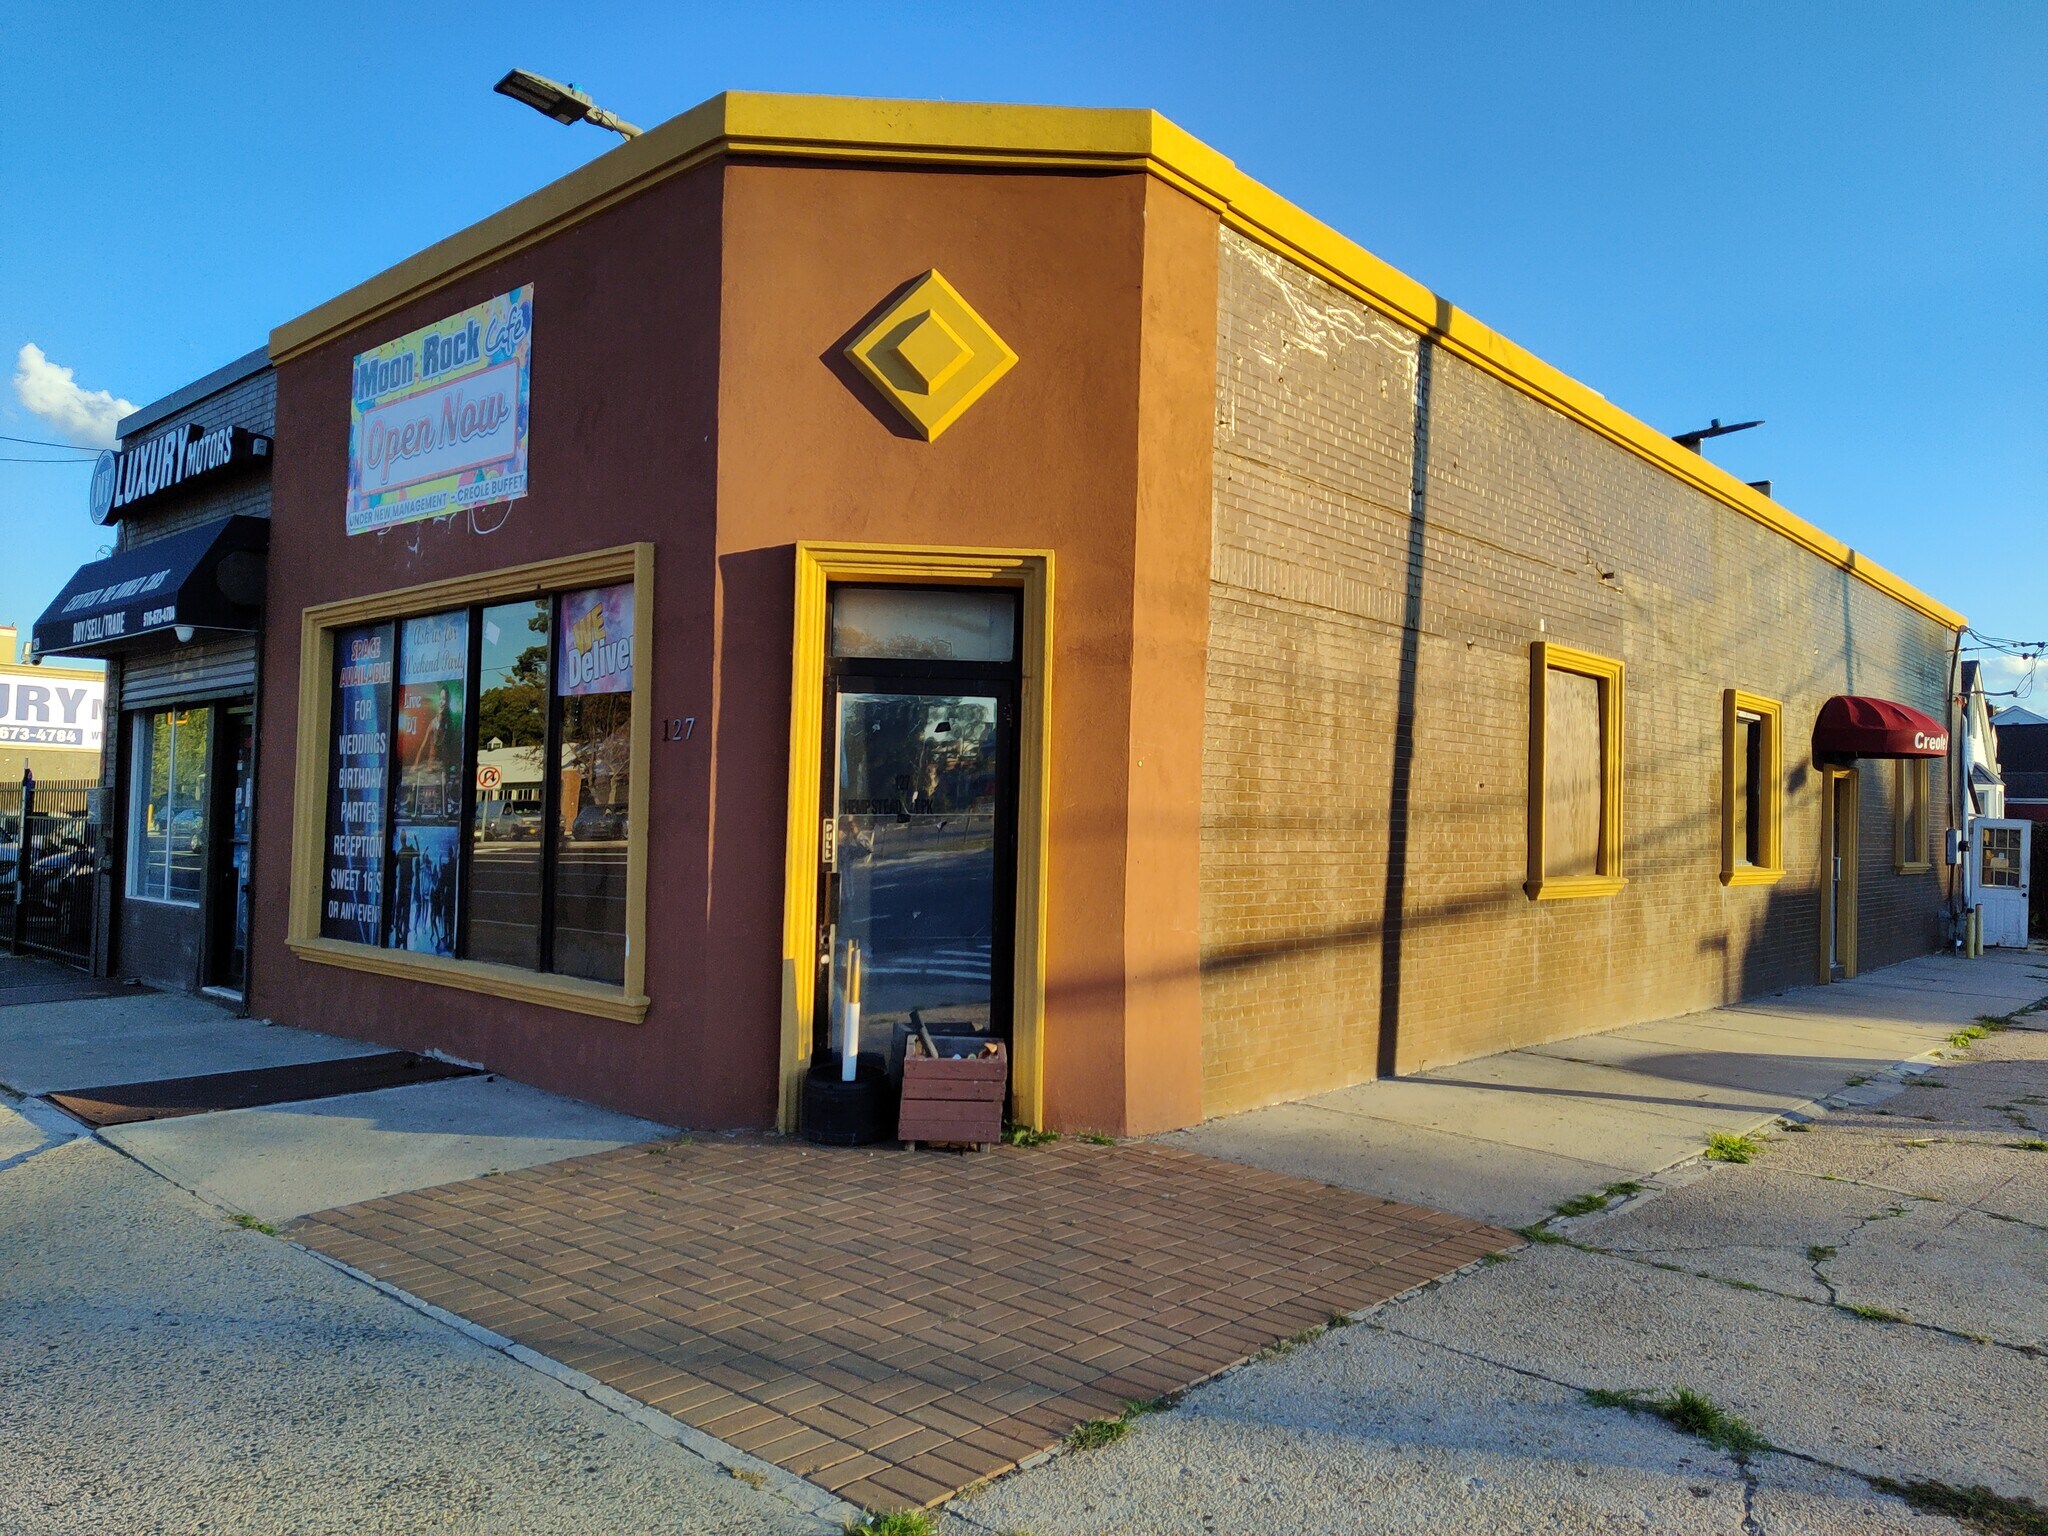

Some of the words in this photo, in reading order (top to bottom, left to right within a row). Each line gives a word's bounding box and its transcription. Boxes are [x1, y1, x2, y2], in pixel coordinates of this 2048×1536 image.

[358, 350, 415, 402] Moon
[422, 317, 481, 381] Rock
[367, 415, 436, 485] Open
[436, 389, 511, 449] Now
[113, 423, 191, 508] LUXURY
[185, 425, 233, 479] MOTORS
[349, 512, 373, 527] UNDER
[374, 506, 391, 521] NEW
[392, 493, 448, 518] MANAGEMENT
[457, 485, 490, 502] CREOLE
[491, 474, 525, 496] BUFFET
[72, 611, 126, 643] BUY/SELL/TRADE
[413, 623, 430, 646] Ask
[432, 628, 441, 643] us
[443, 621, 457, 648] for
[572, 602, 607, 654] WE
[351, 637, 381, 661] SPACE
[340, 661, 391, 688] AVAILABLE
[354, 699, 372, 721] FOR
[404, 693, 421, 710] Live
[0, 727, 76, 742] 673-4784
[406, 716, 417, 735] DJ
[662, 717, 695, 741] 127
[338, 732, 386, 755] WEDDINGS
[338, 767, 383, 789] BIRTHDAY
[895, 774, 910, 790] 127
[340, 801, 377, 823] PARTIES
[844, 799, 901, 814] HEMPSTEAD
[333, 835, 383, 858] RECEPTION
[825, 823, 833, 859] PULL
[330, 868, 360, 891] SWEET
[328, 899, 339, 919] OR
[340, 902, 357, 921] ANY
